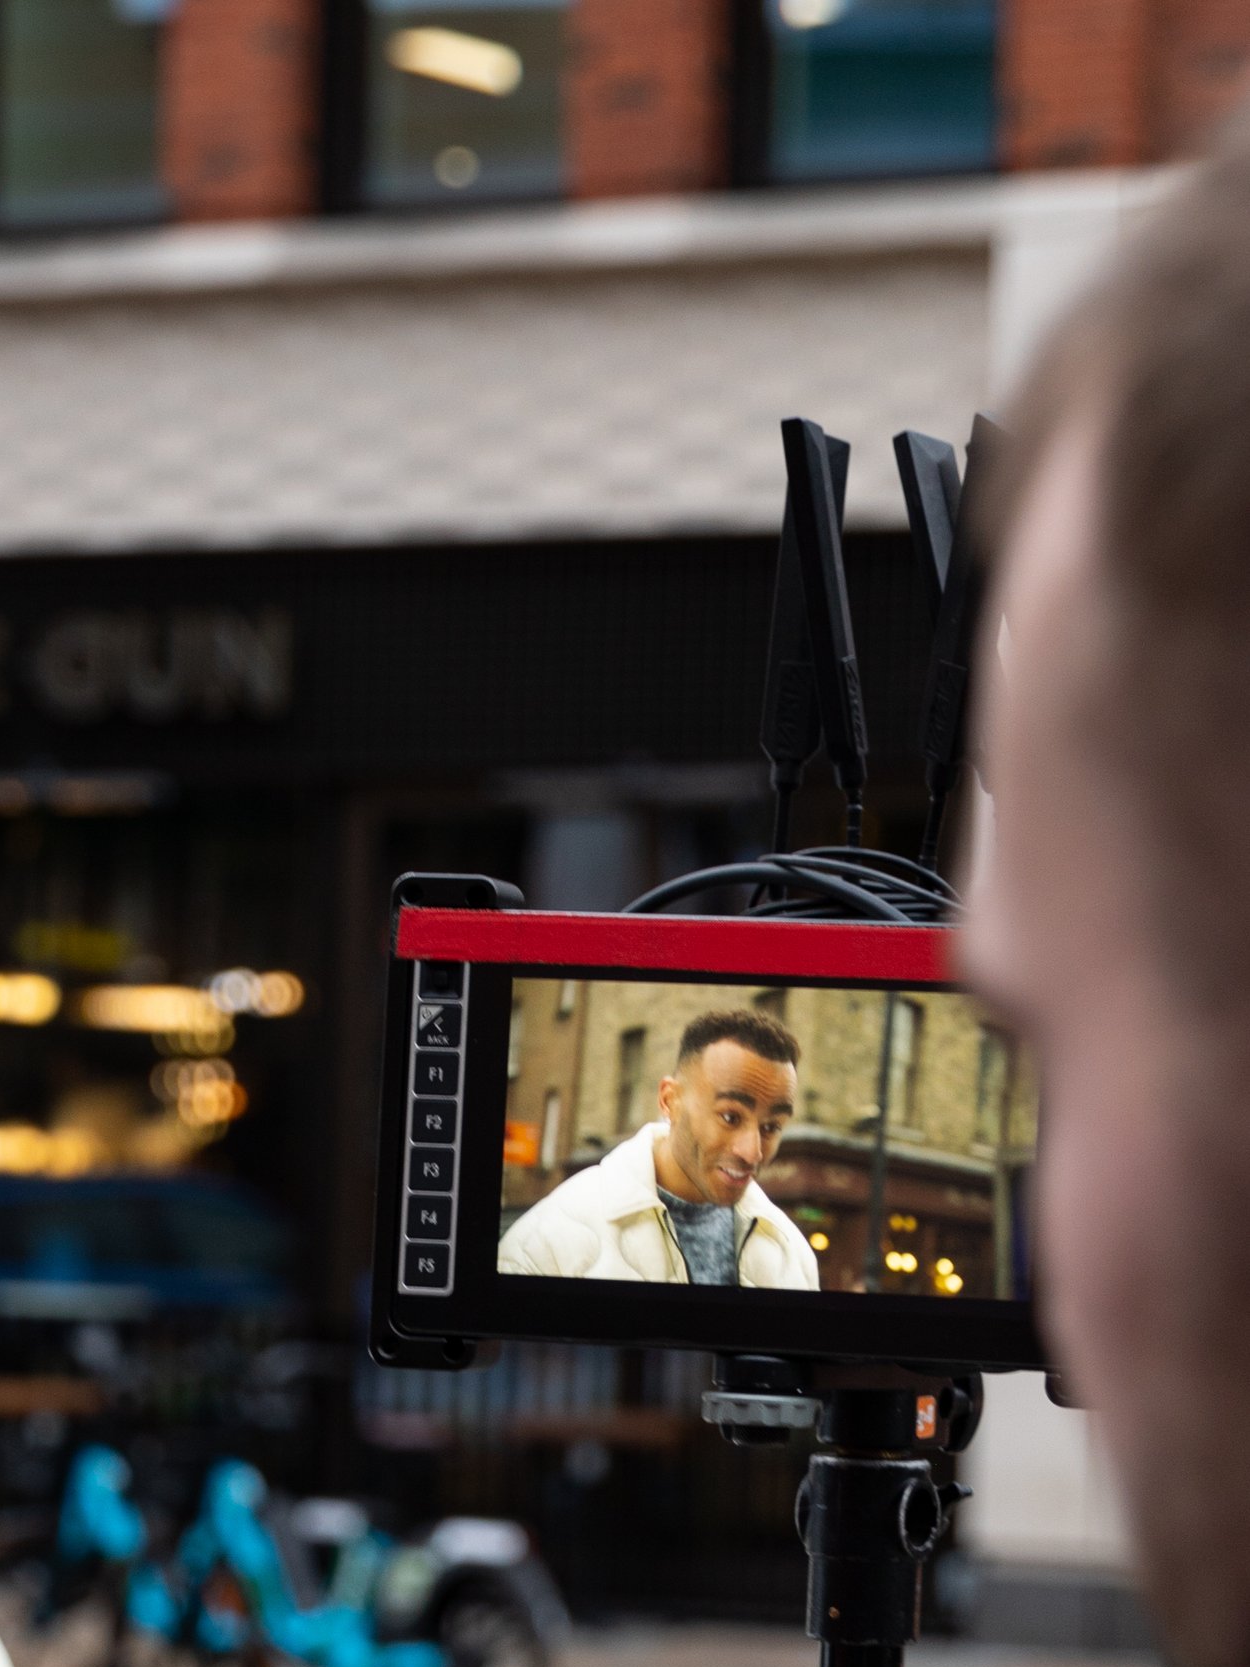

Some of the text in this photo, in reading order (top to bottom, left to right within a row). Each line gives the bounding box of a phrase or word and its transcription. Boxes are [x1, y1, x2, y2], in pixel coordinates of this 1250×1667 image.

[34, 606, 296, 722] GUN
[427, 1034, 450, 1046] BACK
[429, 1066, 444, 1082] F1
[426, 1114, 442, 1130] F2
[423, 1162, 440, 1178] F3
[421, 1209, 438, 1225] F4
[418, 1257, 435, 1273] F5
